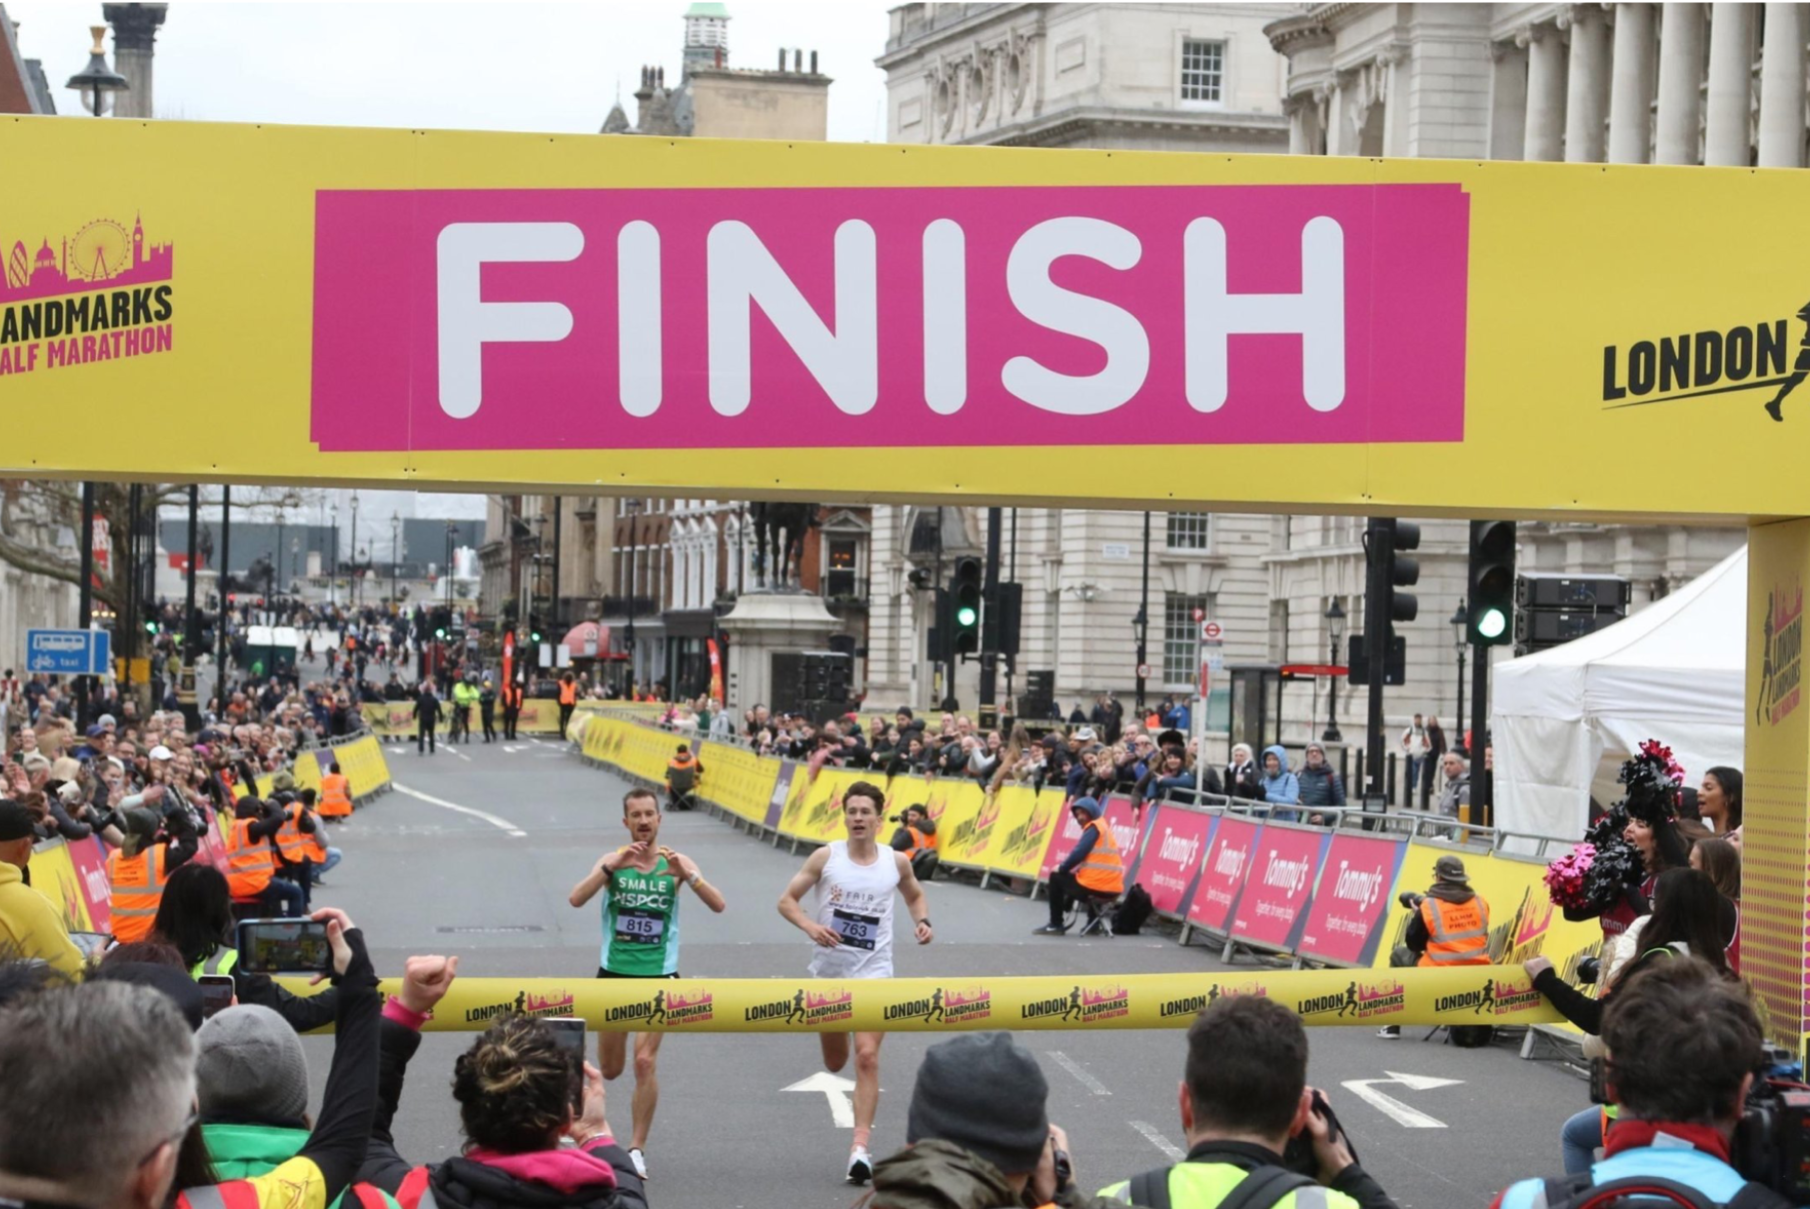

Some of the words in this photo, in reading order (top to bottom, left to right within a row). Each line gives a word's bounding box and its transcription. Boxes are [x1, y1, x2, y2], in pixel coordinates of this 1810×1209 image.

[0, 285, 173, 344] ANDMARKS
[437, 215, 1345, 418] FINISH
[0, 343, 39, 376] ALF
[47, 324, 173, 369] MARATHON
[1602, 319, 1787, 401] LONDON
[60, 657, 79, 667] taxi
[1158, 828, 1199, 872] Tommy's
[1215, 840, 1246, 885] Tommy's
[618, 877, 667, 892] SMALE
[1263, 850, 1309, 899] Tommy's
[846, 891, 875, 902] FAIR
[1333, 860, 1383, 912] Tommy's
[626, 919, 653, 933] 815
[842, 922, 868, 937] 763
[806, 1002, 852, 1018] LANDMARKS
[884, 998, 930, 1020] LONDON
[944, 1001, 991, 1017] LANDMARKS
[1022, 997, 1068, 1018] LONDON
[1082, 999, 1129, 1016] LANDMARKS
[1160, 995, 1206, 1016] LONDON
[1298, 993, 1344, 1014] LONDON
[1358, 994, 1405, 1011] LANDMARKS
[1435, 990, 1481, 1012] LONDON
[1495, 991, 1541, 1008] LANDMARKS
[605, 1001, 651, 1022] LONDON
[666, 1003, 713, 1019] LANDMARKS
[745, 1000, 791, 1021] LONDON
